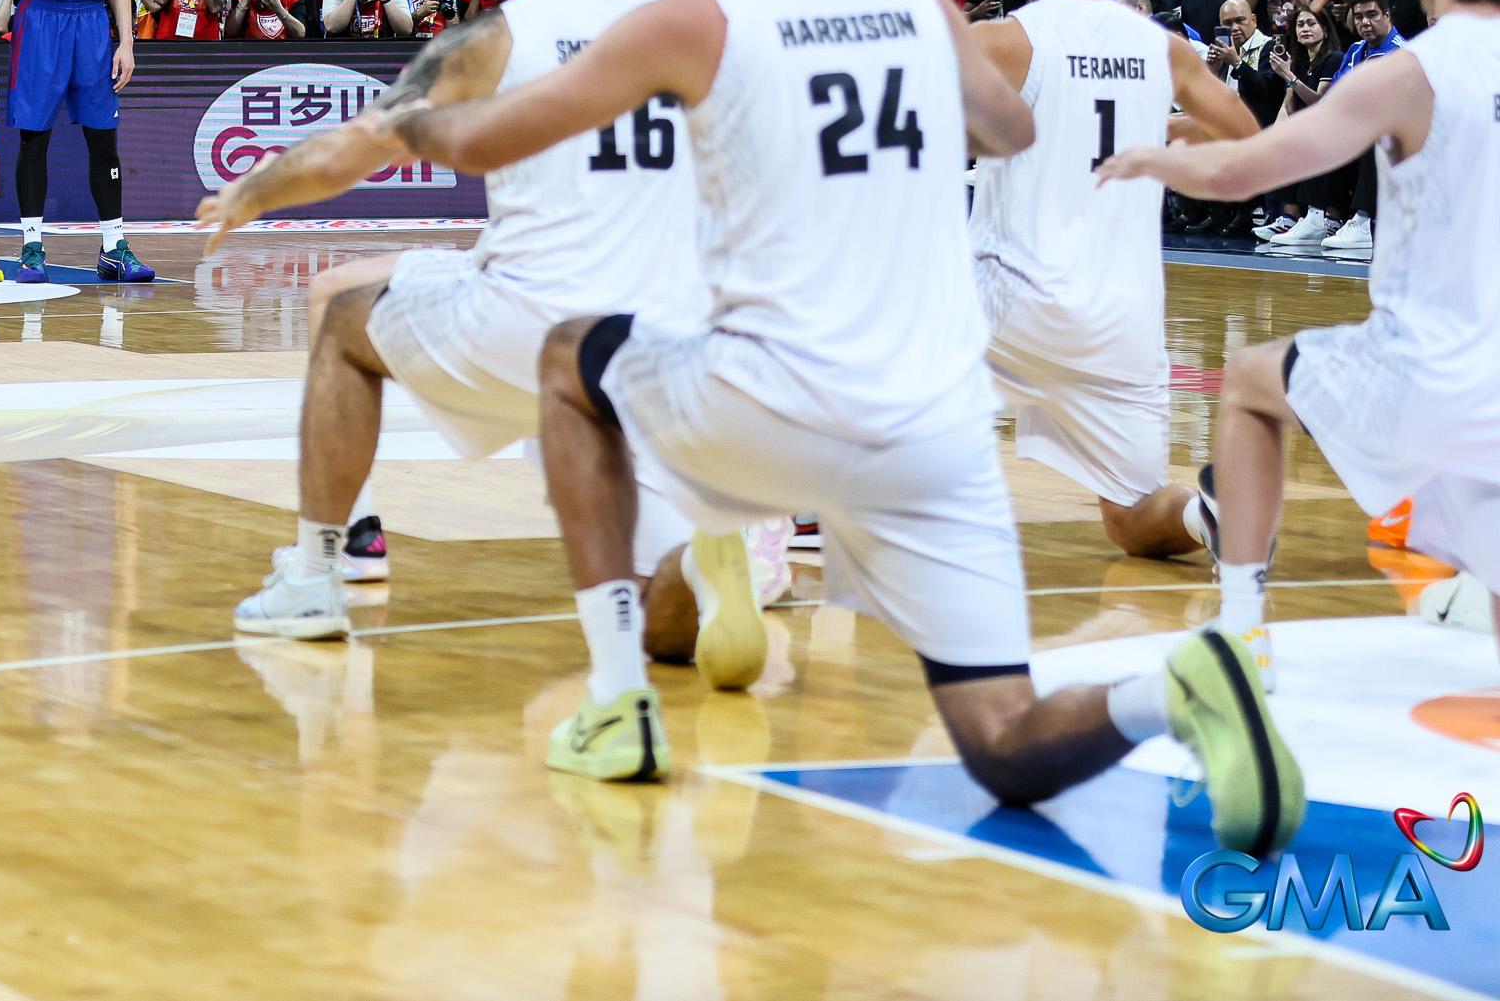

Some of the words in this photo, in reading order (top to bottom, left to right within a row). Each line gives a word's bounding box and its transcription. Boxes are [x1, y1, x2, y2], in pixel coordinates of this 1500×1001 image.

[778, 12, 918, 47] HARRISON
[1067, 56, 1147, 81] TERANGI
[587, 93, 682, 172] 16
[808, 67, 924, 178] 24
[1090, 99, 1116, 174] 1
